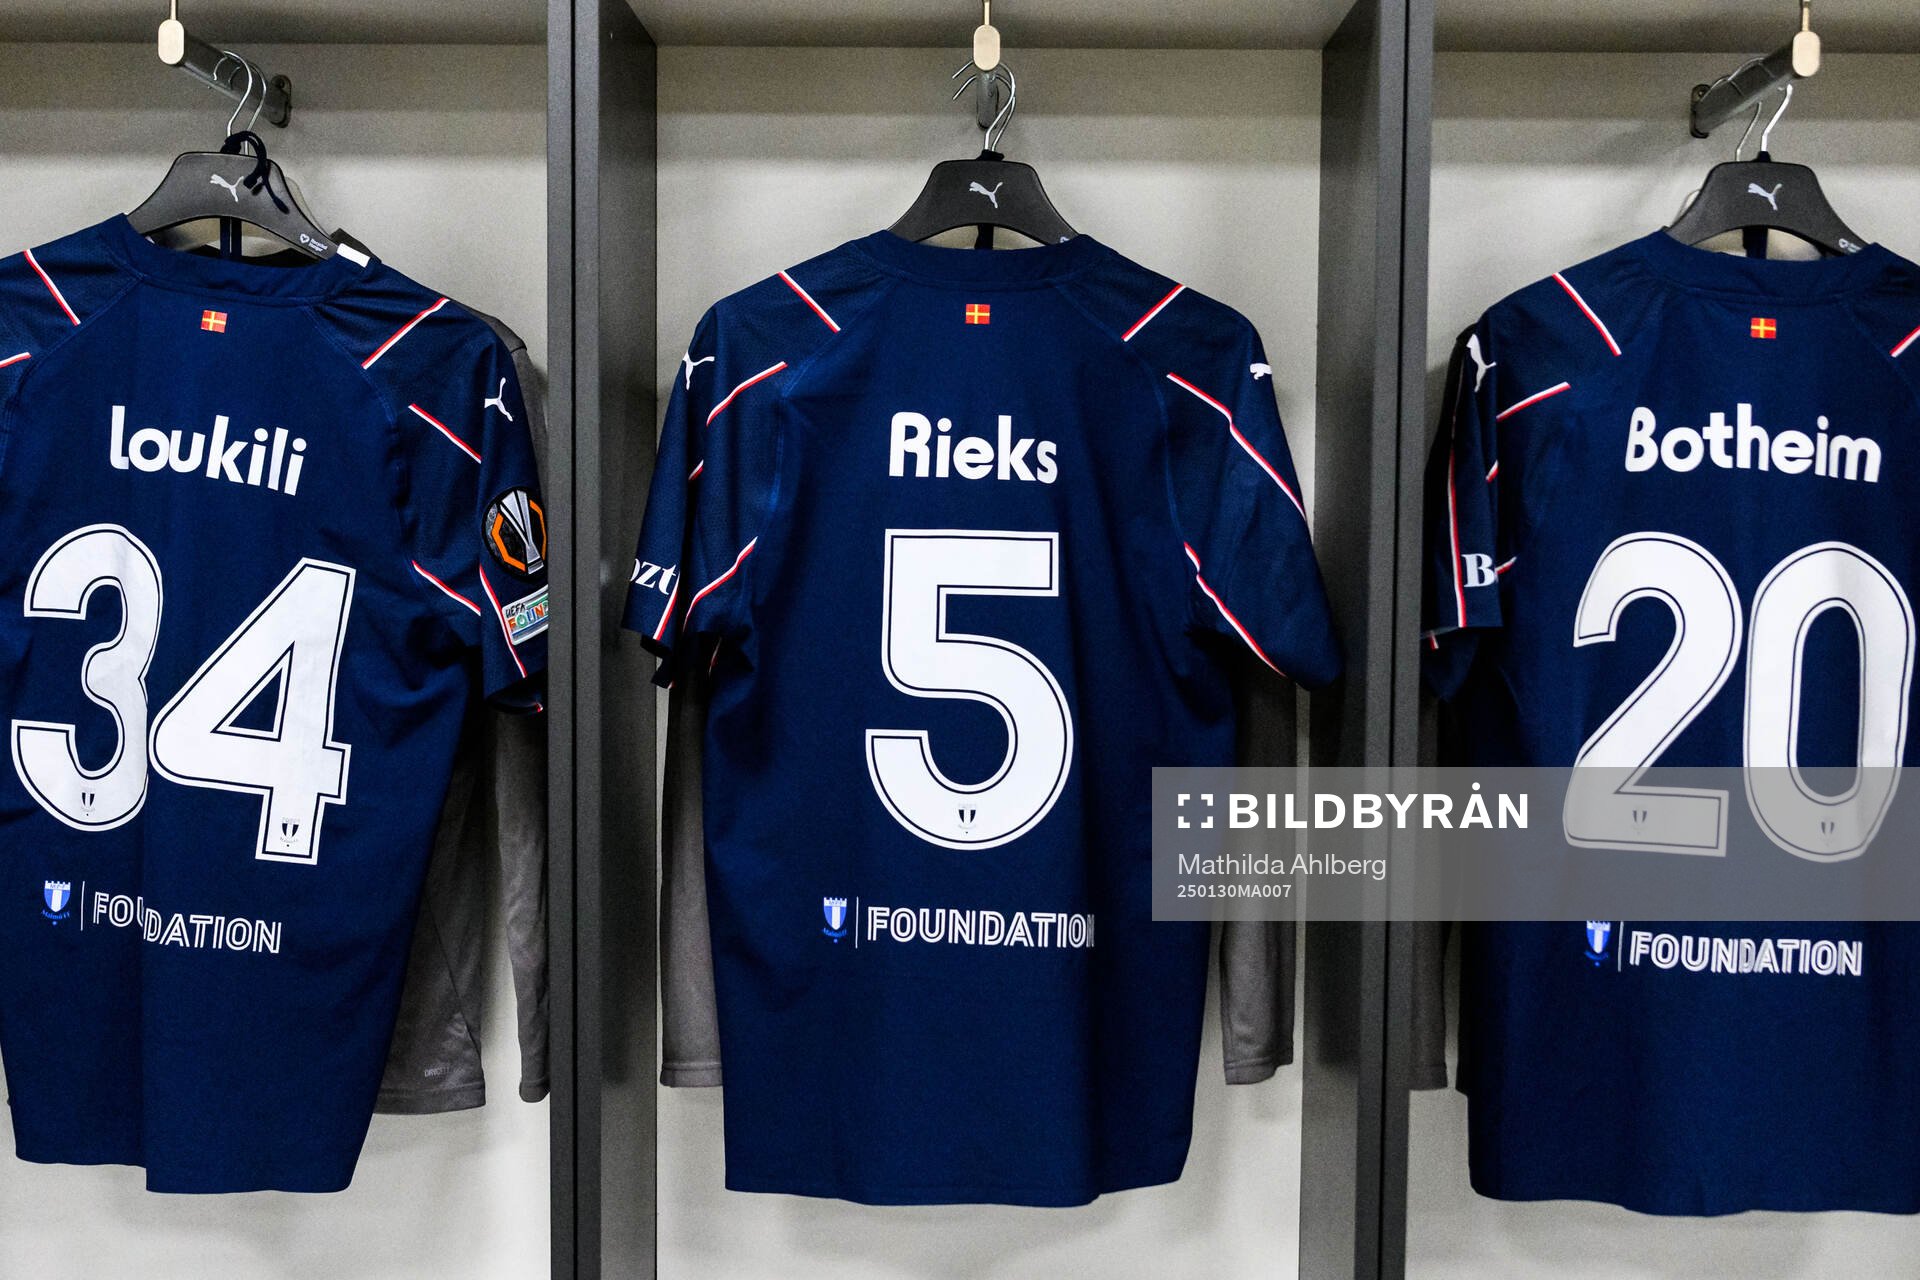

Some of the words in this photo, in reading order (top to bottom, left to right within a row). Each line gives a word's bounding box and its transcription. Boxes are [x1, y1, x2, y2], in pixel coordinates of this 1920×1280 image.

[889, 411, 1058, 484] Rieks
[1625, 403, 1882, 483] Botheim
[505, 603, 526, 618] UEFA
[11, 523, 356, 866] 34
[865, 529, 1074, 850] 5
[1562, 531, 1917, 863] 20
[867, 906, 1095, 949] FOUNDATION
[1629, 930, 1863, 977] FOUNDATION
